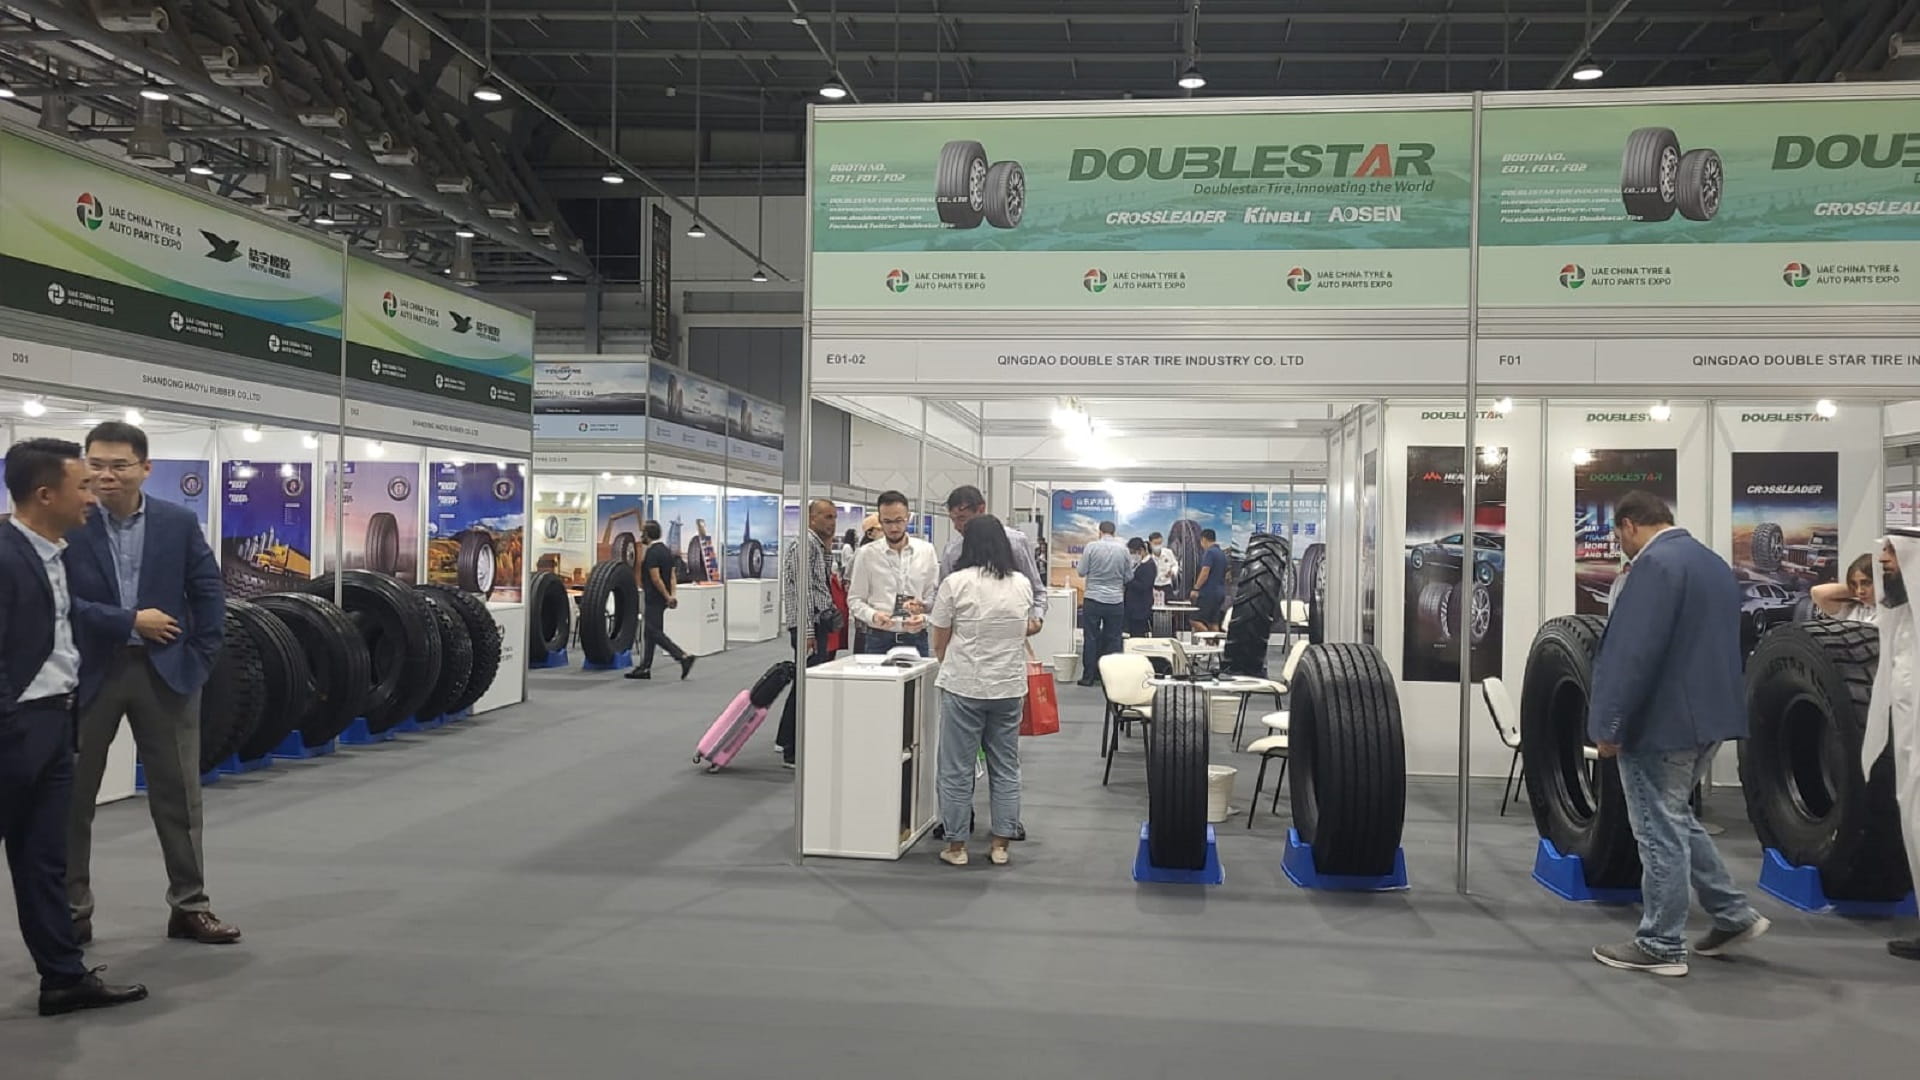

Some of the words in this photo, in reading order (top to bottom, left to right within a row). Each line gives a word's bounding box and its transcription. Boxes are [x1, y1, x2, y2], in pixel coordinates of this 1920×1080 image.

[1068, 143, 1436, 182] DOUBLESTAR
[1193, 182, 1263, 195] Doublestar
[1369, 181, 1391, 193] the
[1394, 180, 1435, 193] World
[1105, 210, 1227, 225] CROSSLEADER
[1327, 205, 1402, 223] AOSEN
[108, 206, 127, 219] UAE
[127, 210, 152, 227] CHINA
[154, 219, 176, 235] TYRE
[175, 227, 182, 237] &
[108, 222, 133, 236] AUTO
[133, 228, 160, 245] PARTS
[161, 236, 182, 251] EXPO
[1317, 271, 1334, 279] UAE
[1335, 271, 1361, 279] CHINA
[1363, 271, 1385, 279] TYRE
[1386, 271, 1393, 279] &
[1591, 267, 1609, 275] UAE
[1610, 267, 1639, 275] CHINA
[1640, 267, 1662, 275] TYRE
[1664, 267, 1671, 275] &
[1817, 265, 1834, 274] UAE
[1836, 265, 1866, 274] CHINA
[1867, 264, 1890, 273] TYRE
[1892, 264, 1900, 273] &
[914, 272, 930, 280] UAE
[931, 272, 956, 280] CHINA
[958, 272, 977, 280] TYRE
[979, 272, 986, 280] &
[1113, 272, 1129, 280] UAE
[1130, 272, 1156, 280] CHINA
[1158, 272, 1177, 280] TYRE
[1180, 272, 1186, 280] &
[1591, 278, 1616, 286] AUTO
[1617, 278, 1646, 286] PARTS
[1648, 278, 1671, 286] EXPO
[1816, 276, 1841, 284] AUTO
[1843, 275, 1873, 284] PARTS
[1875, 275, 1900, 284] EXPO
[12, 352, 30, 364] D01
[826, 353, 866, 365] E01-02
[997, 354, 1057, 367] QINGDAO
[1059, 354, 1113, 366] DOUBLE
[1116, 354, 1150, 366] STAR
[1154, 354, 1182, 366] TIRE
[1185, 354, 1250, 366] INDUSTRY
[1254, 354, 1276, 366] CO.
[1281, 354, 1304, 366] LTD
[1499, 354, 1522, 366] F01
[1692, 354, 1760, 367] QINGDAO
[1764, 354, 1823, 366] DOUBLE
[1828, 354, 1866, 366] STAR
[1872, 354, 1902, 366] TIRE
[142, 374, 183, 390] SHANDONG
[184, 380, 209, 393] HAOYU
[209, 384, 236, 398] RUBBER
[1746, 485, 1823, 494] CROSSLEADER
